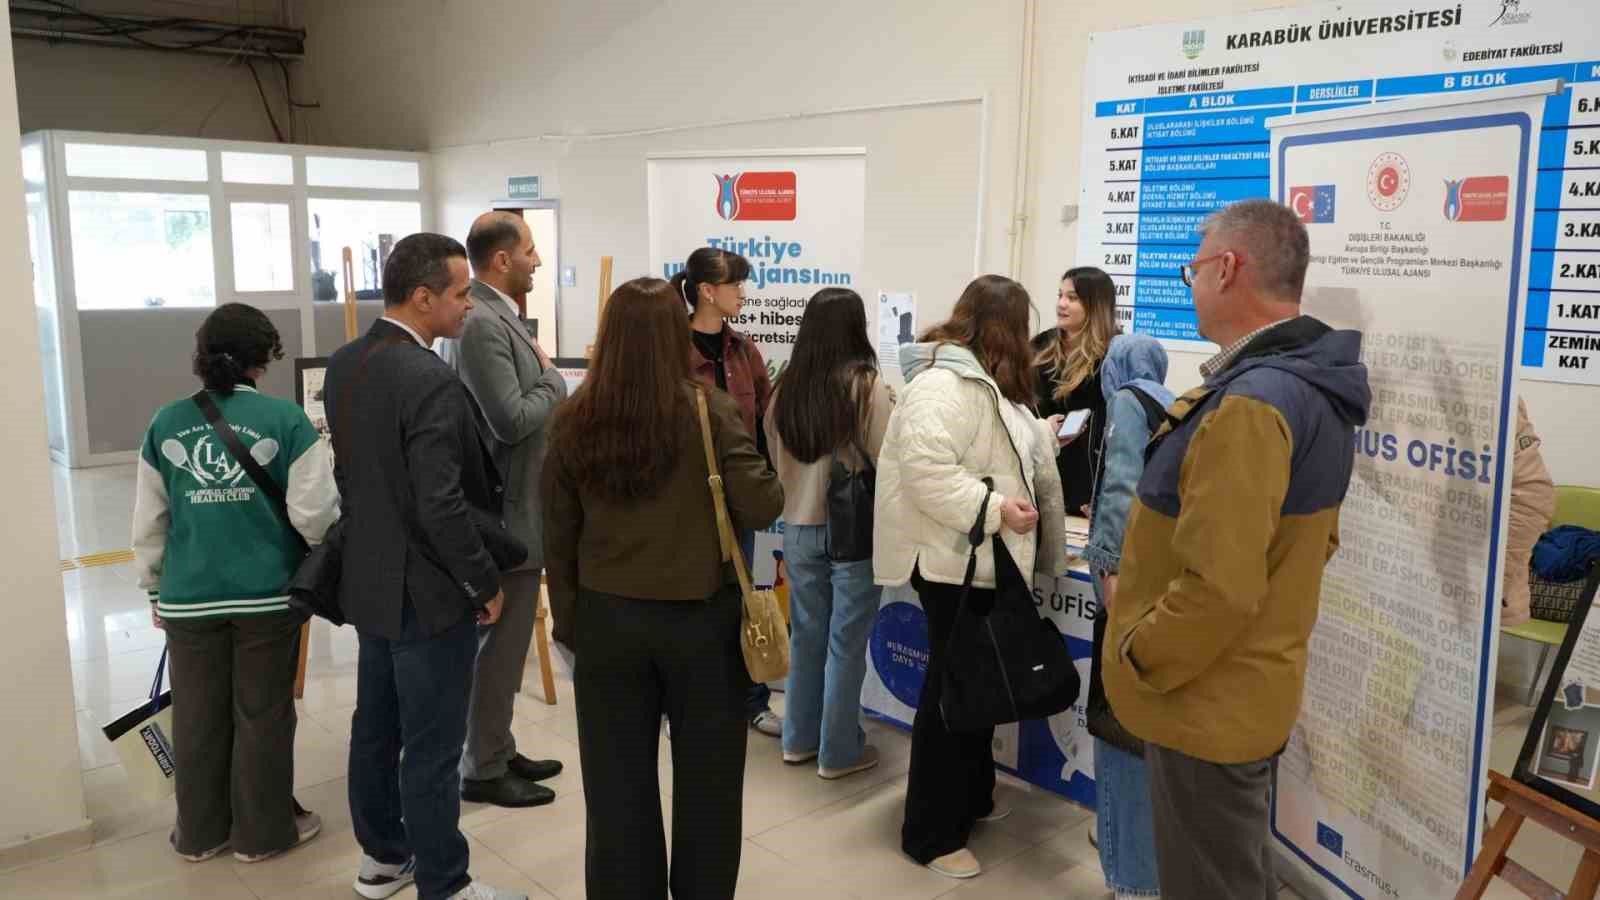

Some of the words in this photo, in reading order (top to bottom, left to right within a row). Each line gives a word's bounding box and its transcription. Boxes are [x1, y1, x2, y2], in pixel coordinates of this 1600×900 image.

[1226, 22, 1312, 50] KARABÜK
[1318, 4, 1463, 41] ÜNİVERSİTESİ
[1463, 48, 1508, 62] EDEBİYAT
[1510, 42, 1563, 58] FAKÜLTESİ
[1128, 74, 1156, 85] İKTİSADİ
[1157, 72, 1165, 81] VE
[1167, 69, 1186, 80] İDARİ
[1187, 66, 1220, 78] BİLİMLER
[1222, 62, 1260, 75] FAKÜLTESİ
[1443, 76, 1455, 89] B
[1461, 72, 1507, 87] BLOK
[1158, 84, 1187, 96] İŞLETME
[1188, 80, 1224, 93] FAKÜLTESİ
[1309, 85, 1360, 101] DERSLİKLER
[1116, 102, 1136, 114] KAT
[1189, 97, 1198, 108] A
[1202, 94, 1234, 108] BLOK
[1577, 97, 1600, 113] 6.K
[1110, 126, 1138, 140] 6.KAT
[1109, 159, 1137, 172] 5.KAT
[1107, 191, 1135, 203] 4.KAT
[1106, 223, 1134, 234] 3.KAT
[707, 236, 802, 264] Türkiye
[1169, 252, 1196, 261] FAKÜLT
[1105, 254, 1133, 265] 2.KAT
[1341, 266, 1371, 276] TÜRKİYE
[1372, 267, 1400, 277] ULUSAL
[1403, 268, 1431, 278] AJANSI
[760, 311, 802, 326] hibes
[1549, 335, 1600, 352] ZEMİN
[1559, 354, 1589, 369] KAT
[205, 443, 232, 473] LA
[1407, 437, 1492, 485] OFİSİ
[191, 493, 226, 505] HEALTH
[226, 491, 250, 502] CLUB
[1050, 591, 1097, 621] OFİS
[1344, 847, 1400, 898] Erasmus+
